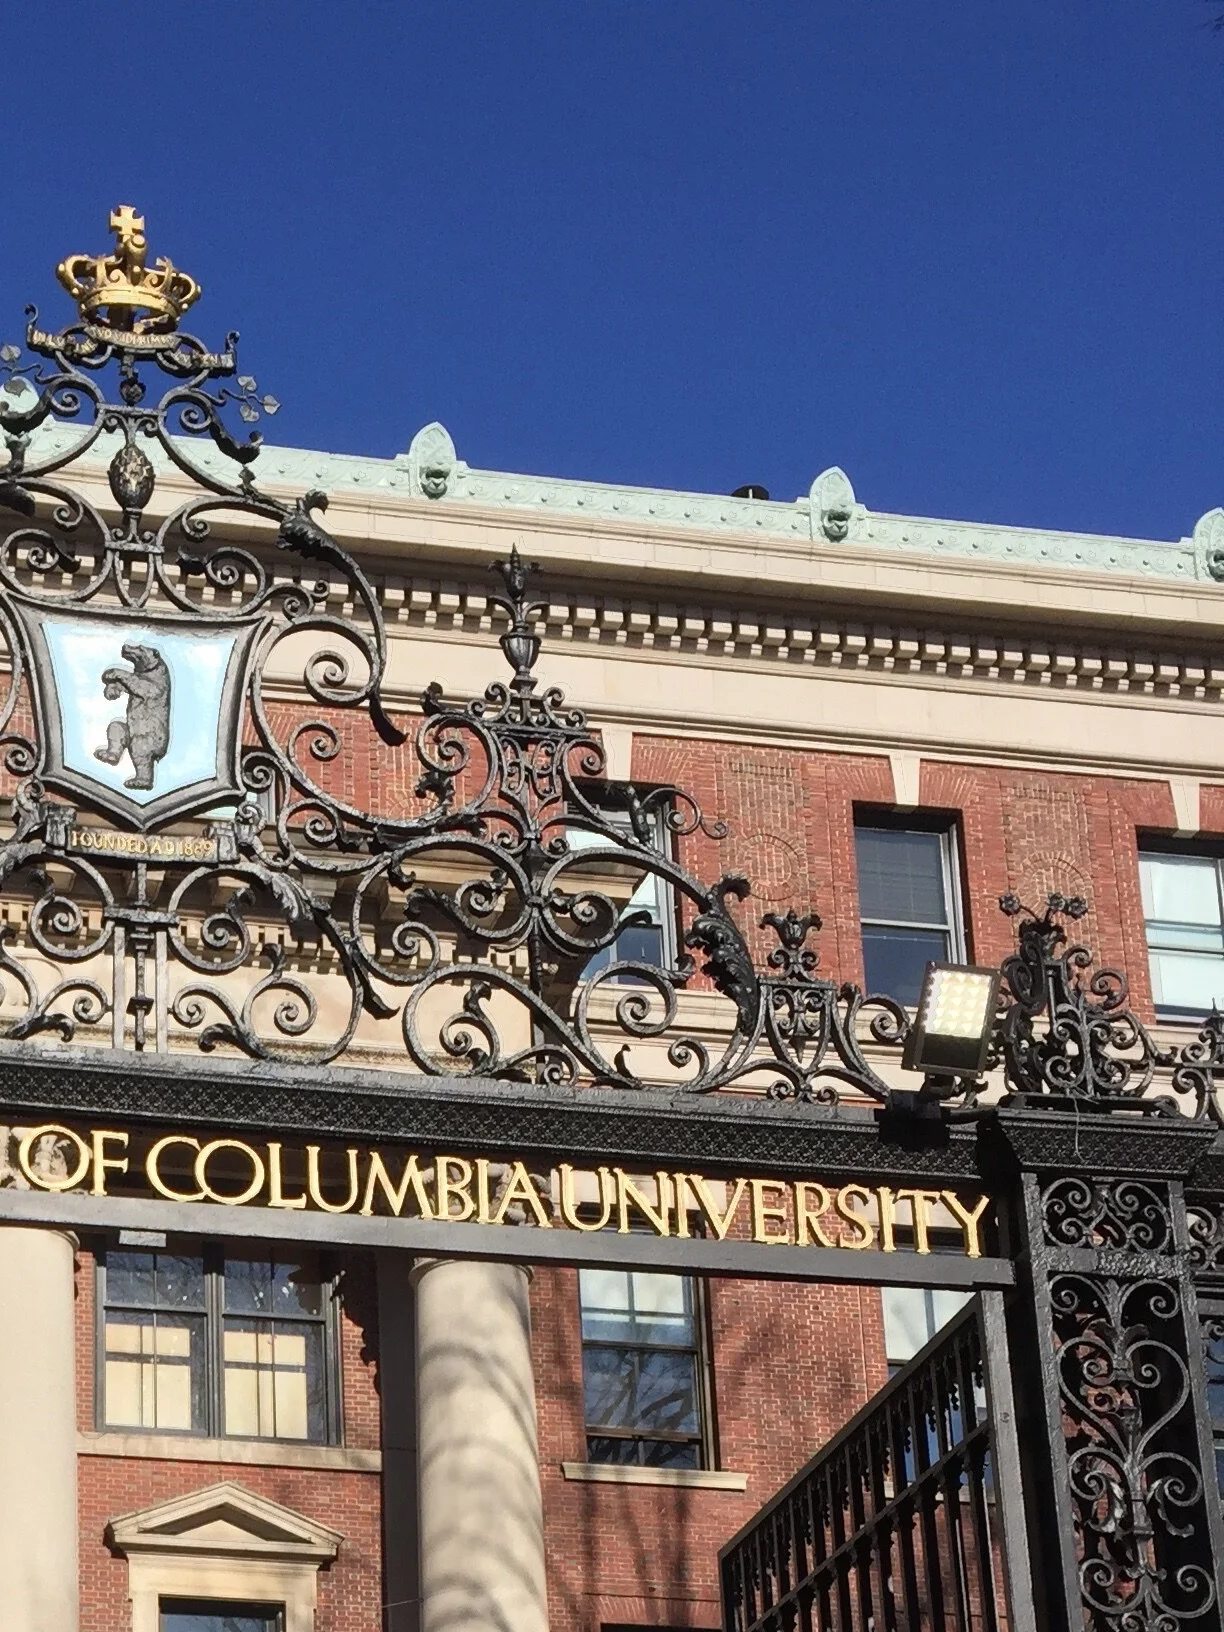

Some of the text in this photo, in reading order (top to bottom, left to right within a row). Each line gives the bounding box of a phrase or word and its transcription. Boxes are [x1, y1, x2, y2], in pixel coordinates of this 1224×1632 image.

[71, 830, 148, 854] FOUNDED
[179, 840, 215, 858] 1889
[18, 1123, 130, 1198] OF
[145, 1135, 553, 1229] COLUMBIA
[558, 1162, 991, 1259] UNIVERSITY
